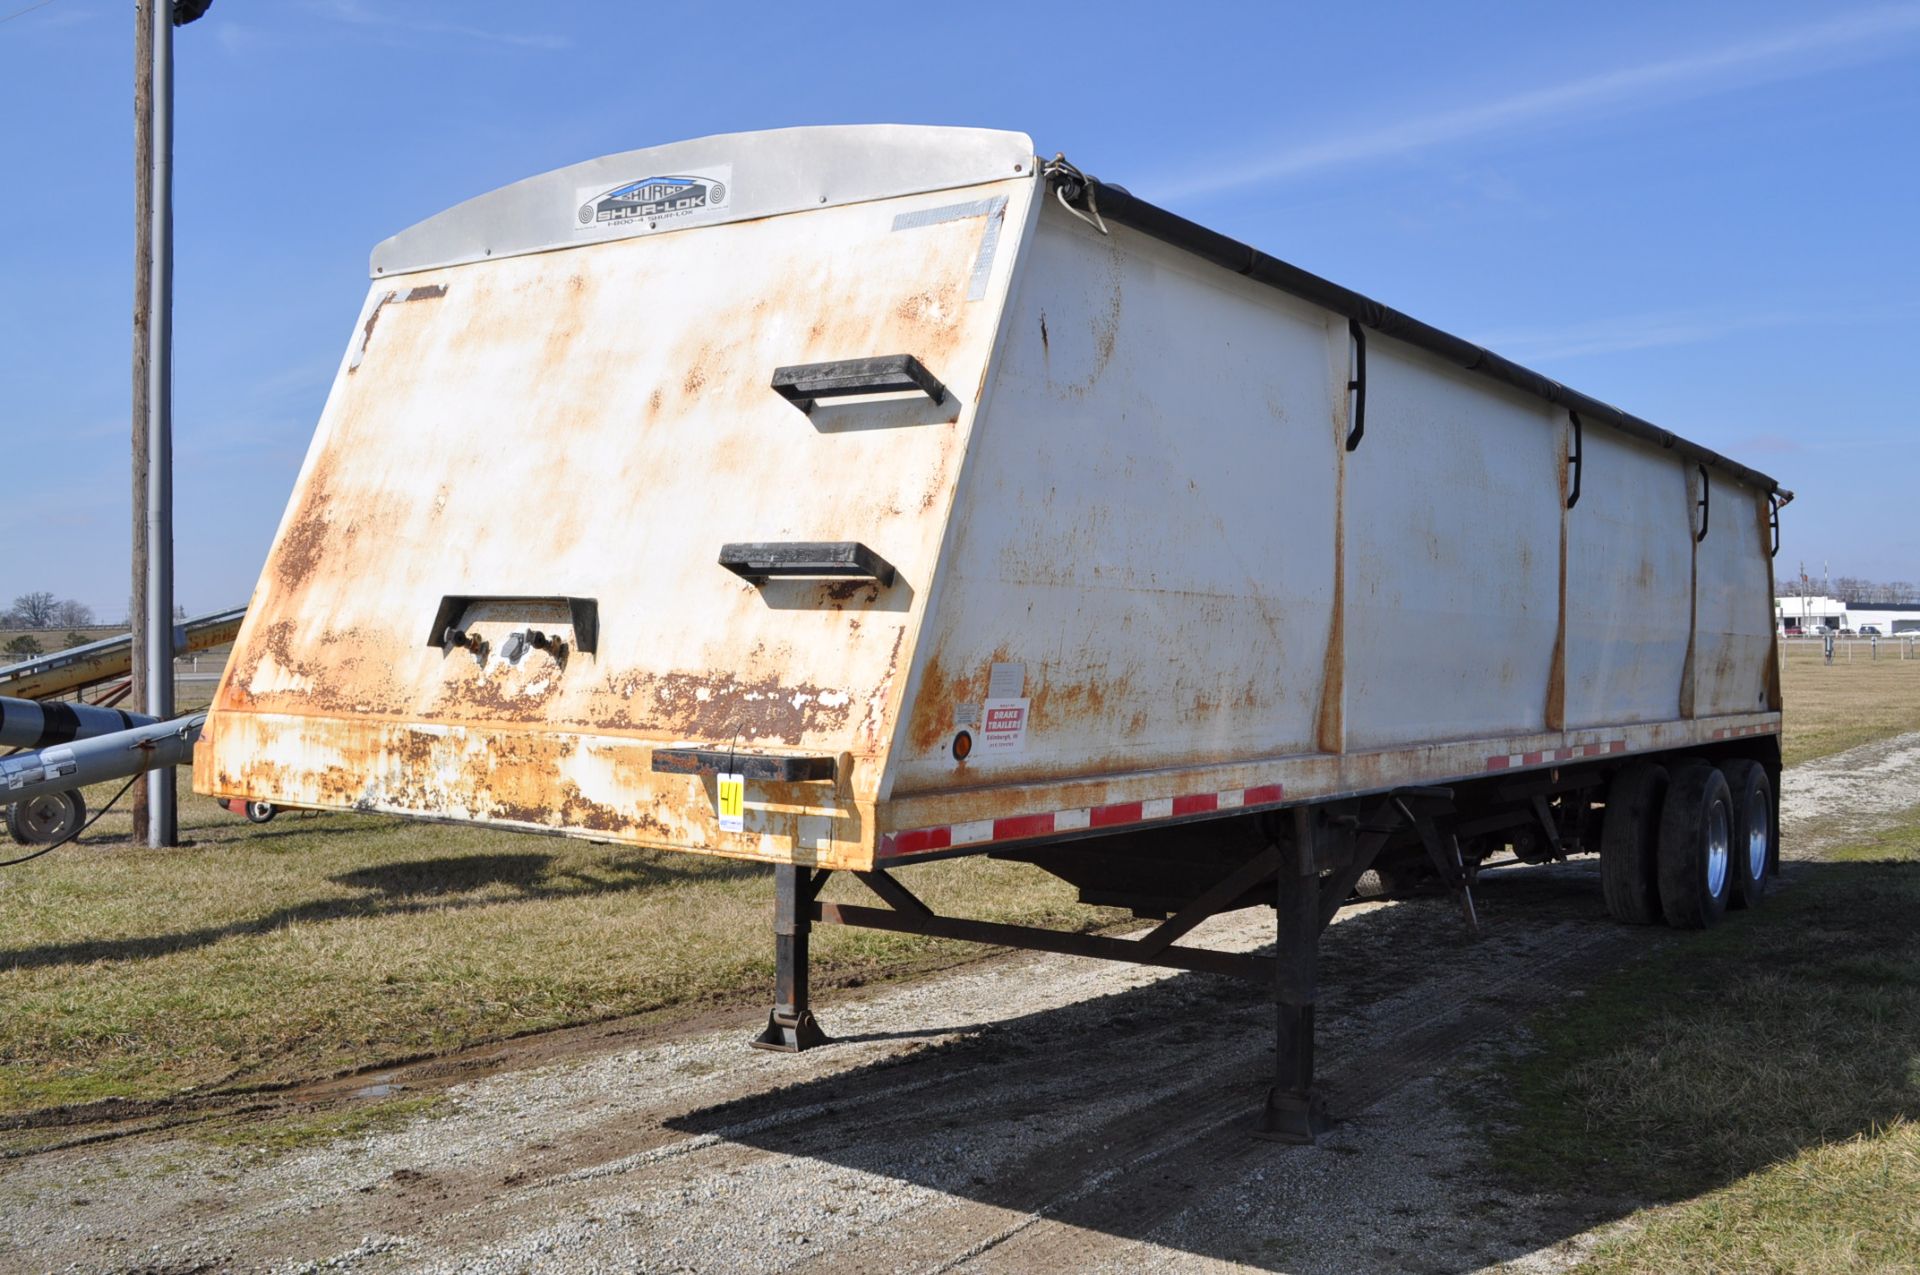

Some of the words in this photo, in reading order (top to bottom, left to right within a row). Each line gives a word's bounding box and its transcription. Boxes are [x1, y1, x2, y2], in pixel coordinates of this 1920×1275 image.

[597, 195, 705, 221] SHUR-LOK
[993, 710, 1018, 719] DRAKE
[720, 782, 738, 815] 41
